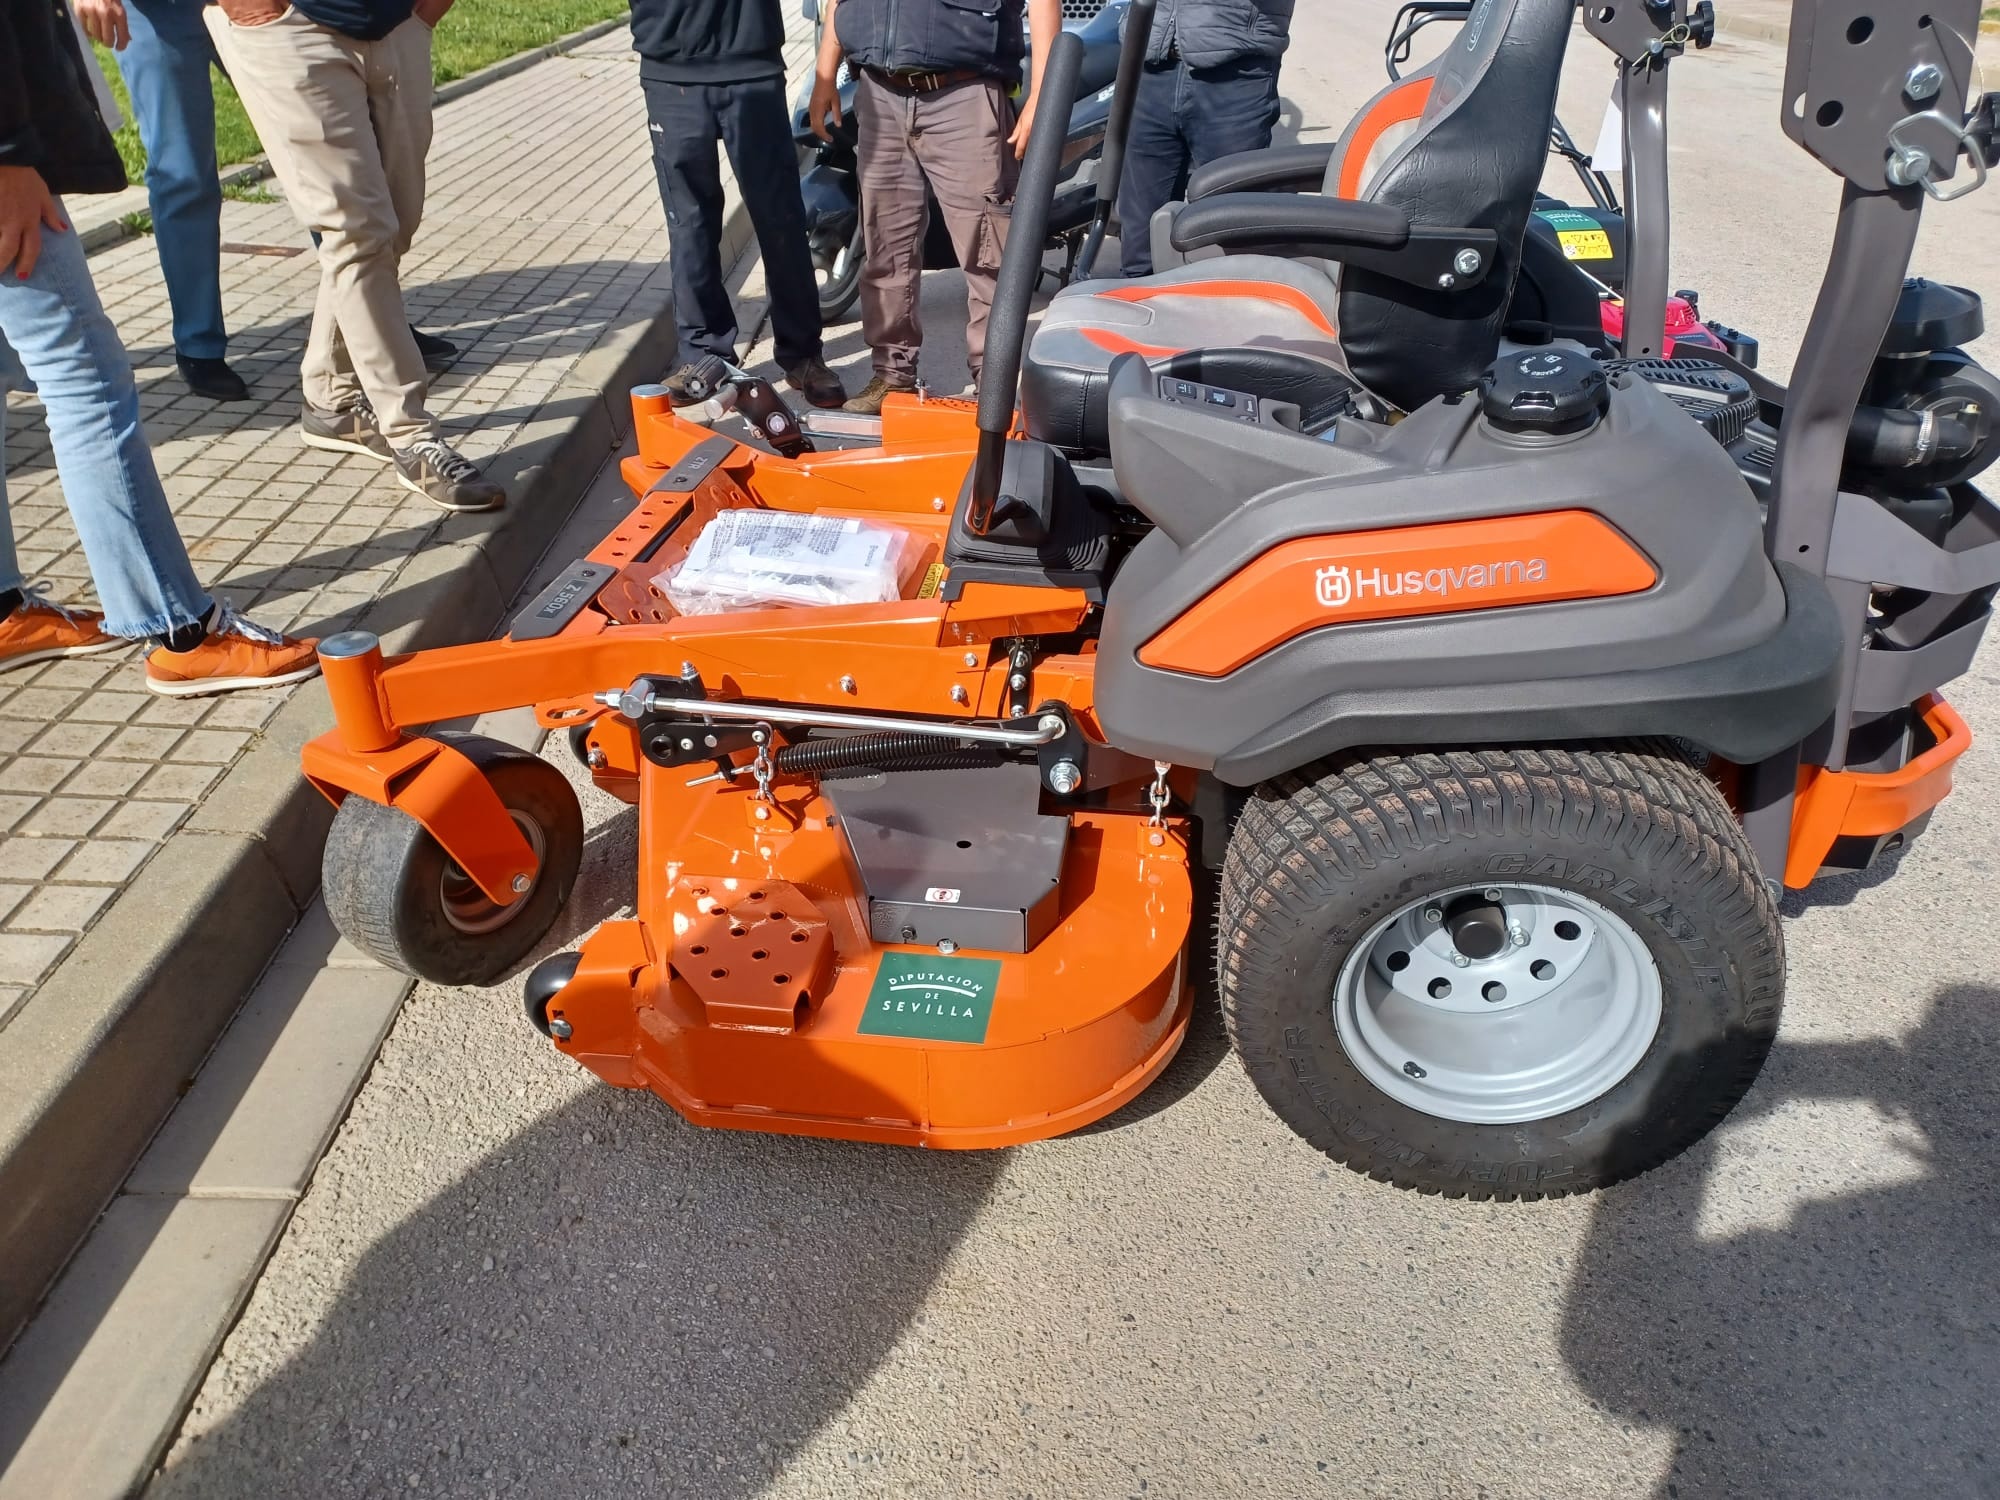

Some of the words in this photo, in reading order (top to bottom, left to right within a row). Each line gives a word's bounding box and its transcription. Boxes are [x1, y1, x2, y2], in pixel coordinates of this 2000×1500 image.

[687, 456, 708, 470] ZTR
[1355, 557, 1548, 598] Husqvarna
[543, 591, 574, 614] 560x
[888, 973, 983, 992] DIPUTACION
[924, 992, 940, 1000] DE
[882, 1000, 974, 1018] SEVILLA
